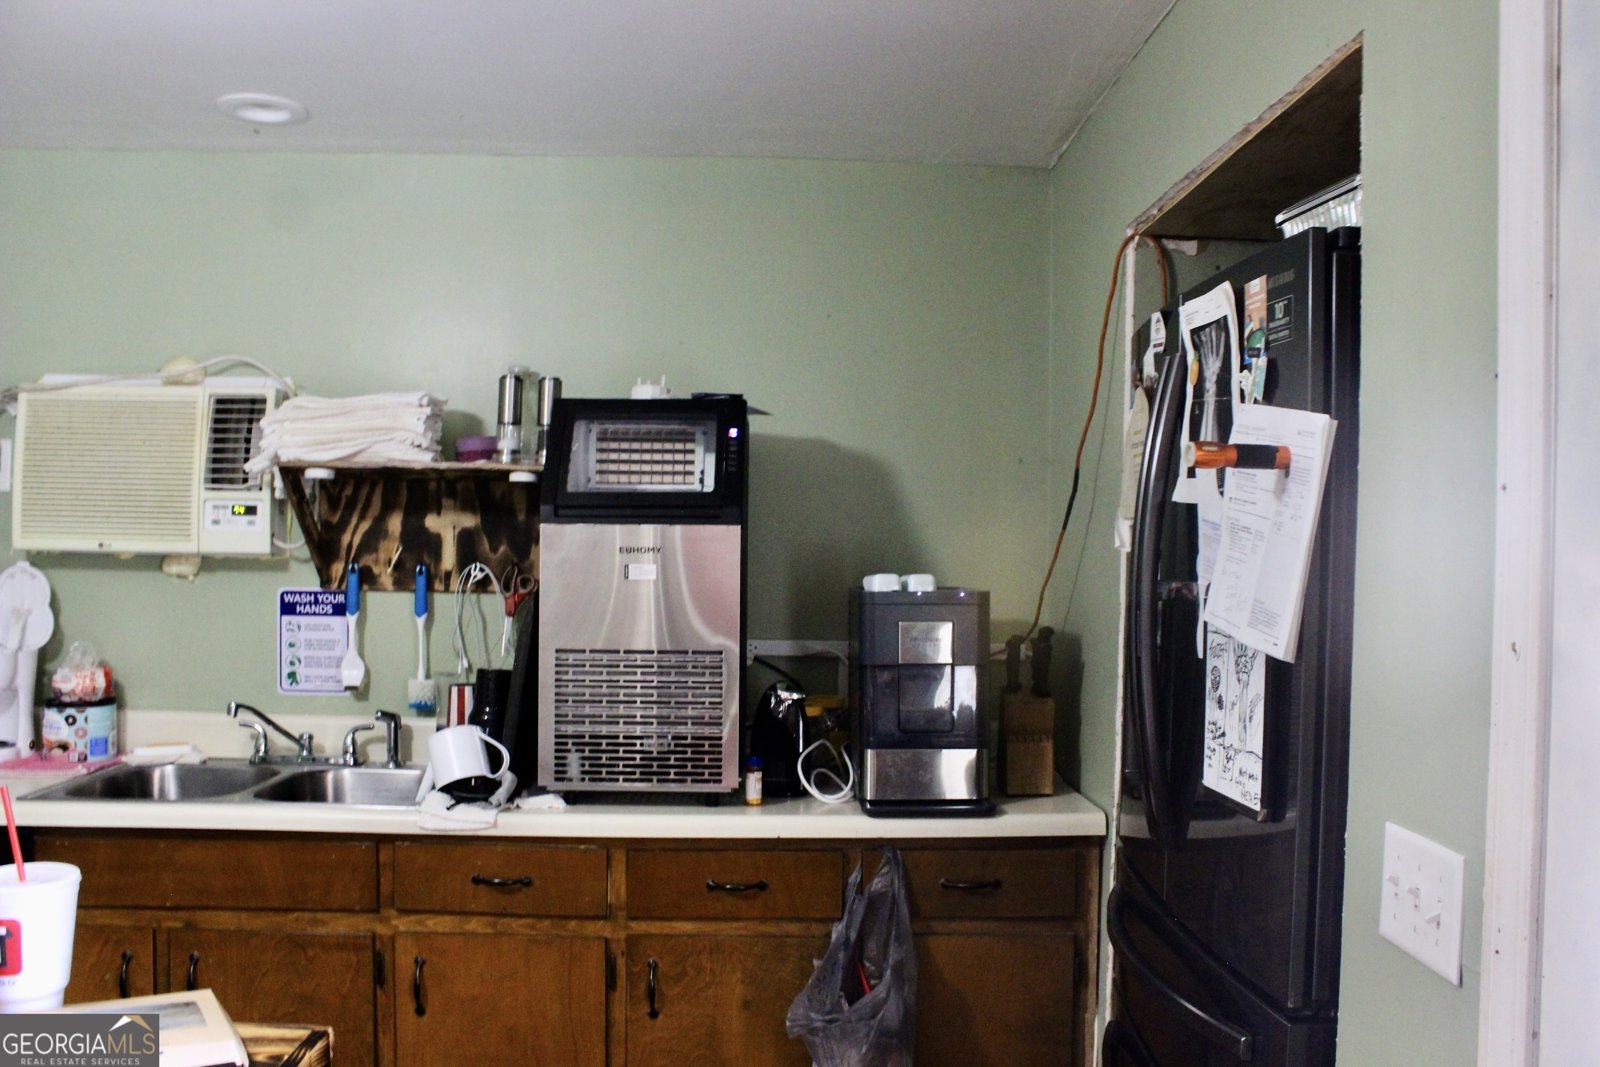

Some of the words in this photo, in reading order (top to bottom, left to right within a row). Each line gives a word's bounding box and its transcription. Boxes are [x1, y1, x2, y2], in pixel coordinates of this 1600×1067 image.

[619, 546, 662, 554] EUHOMY
[283, 593, 314, 603] WASH
[317, 593, 345, 604] YOUR
[296, 604, 333, 615] HANDS
